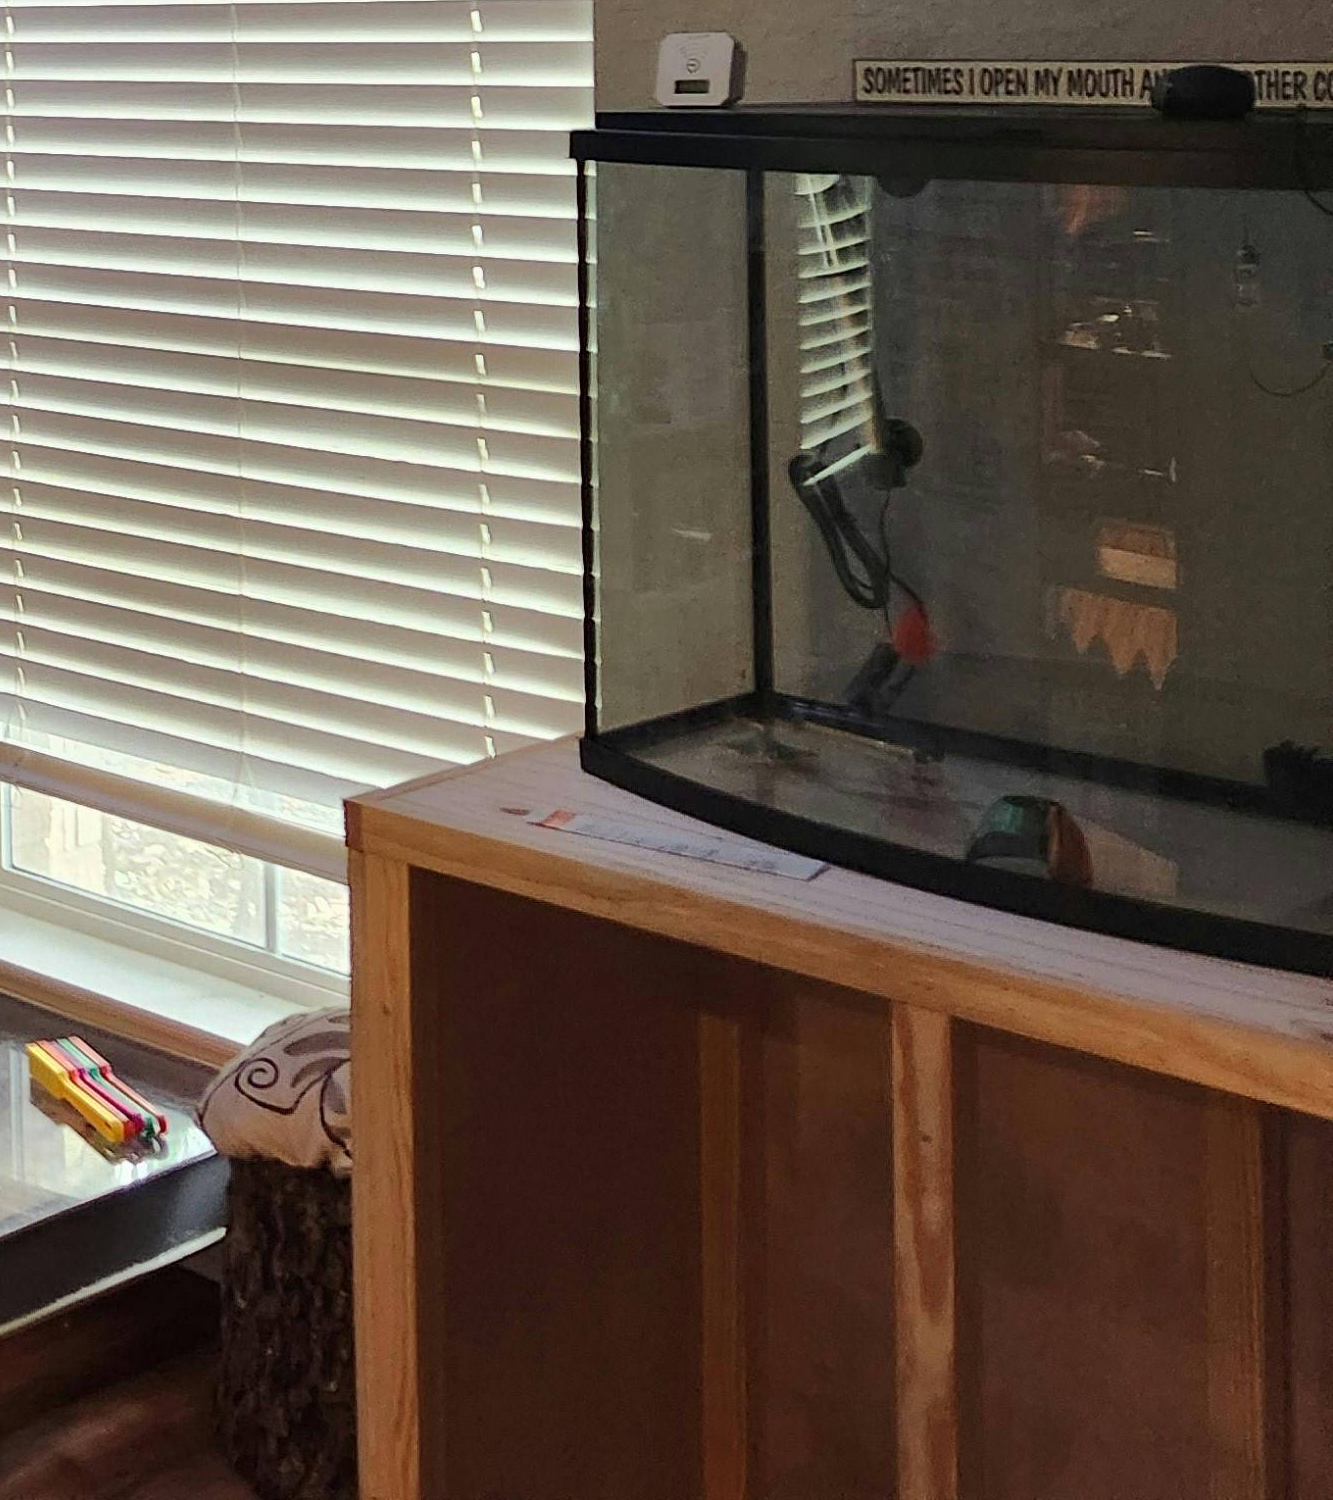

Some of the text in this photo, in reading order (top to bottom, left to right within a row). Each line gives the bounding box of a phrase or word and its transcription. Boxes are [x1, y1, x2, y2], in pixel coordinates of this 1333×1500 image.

[863, 65, 962, 96] SOMETIMES
[968, 66, 975, 96] I
[980, 66, 1028, 98] OPEN
[1033, 66, 1060, 98] MY
[1067, 66, 1135, 99] MOUTH
